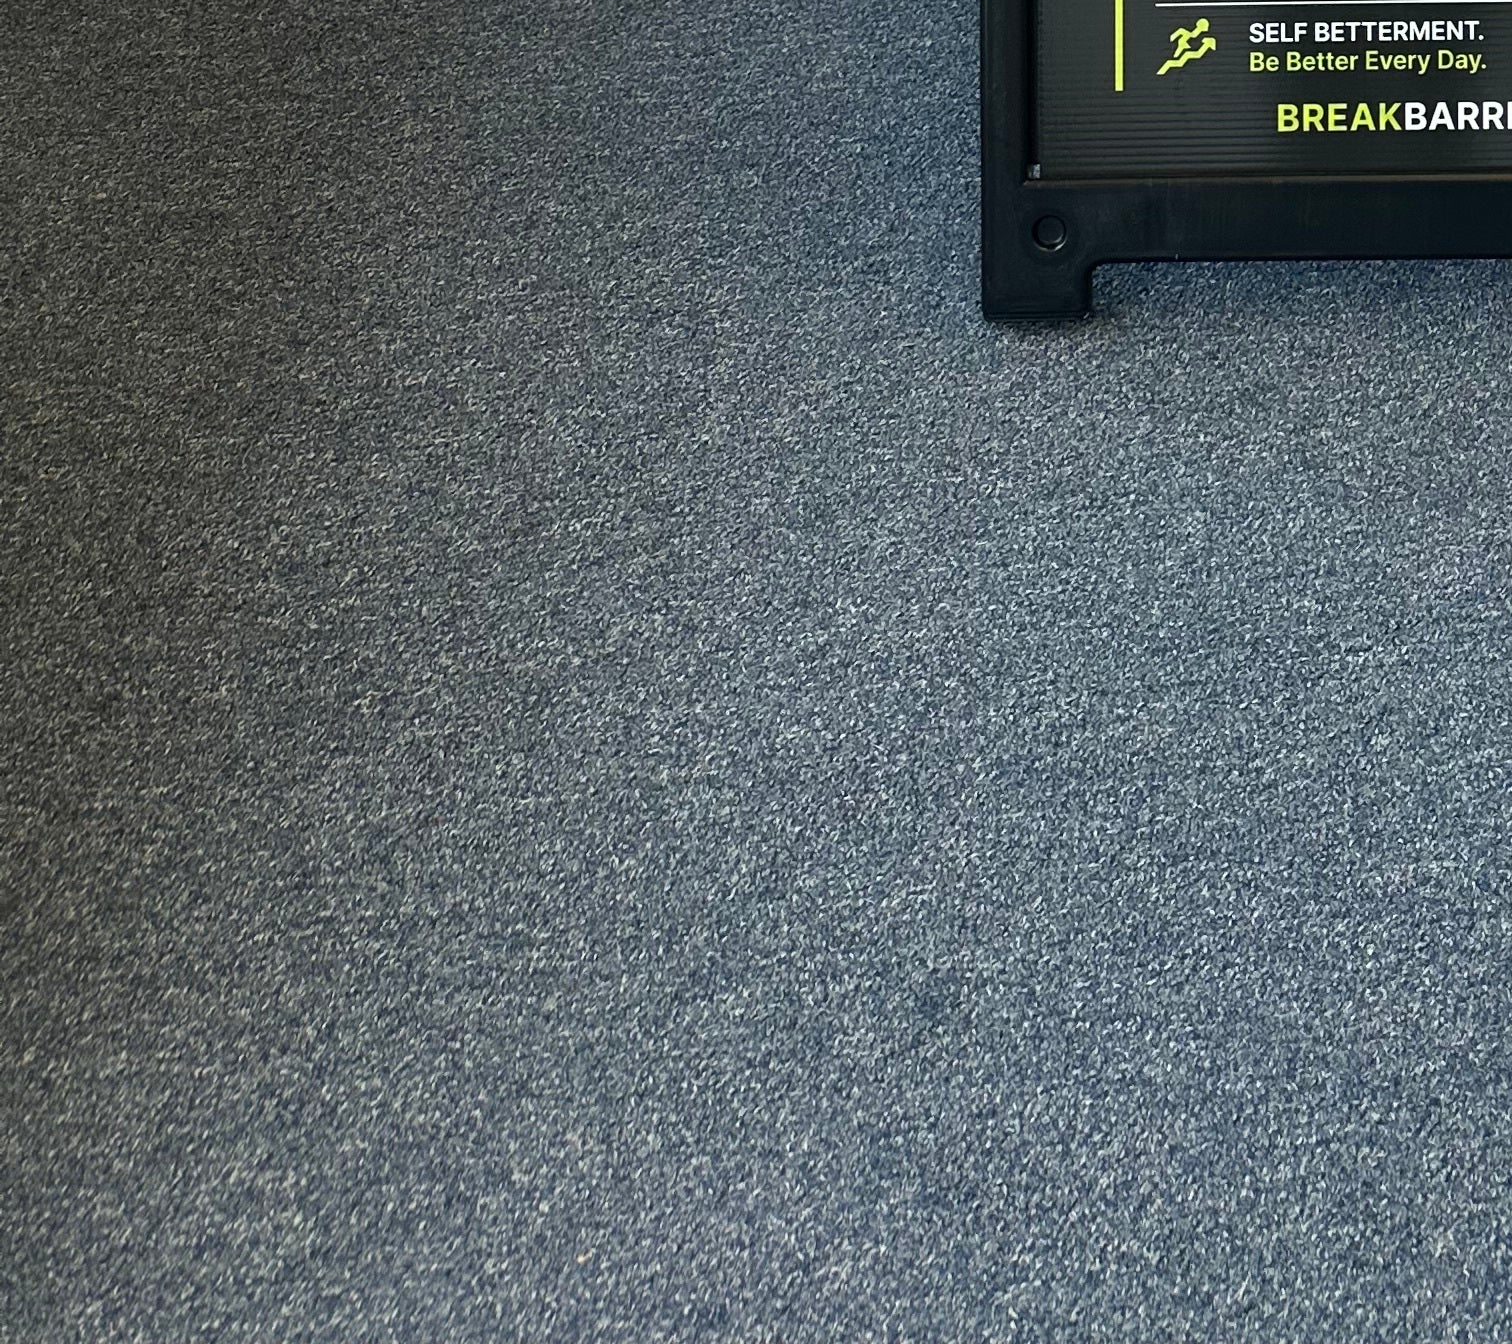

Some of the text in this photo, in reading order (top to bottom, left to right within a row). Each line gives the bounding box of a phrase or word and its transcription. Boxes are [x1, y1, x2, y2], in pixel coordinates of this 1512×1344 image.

[1249, 20, 1485, 43] SELF BETTERMENT.
[1249, 49, 1487, 75] Be Better Every Day.
